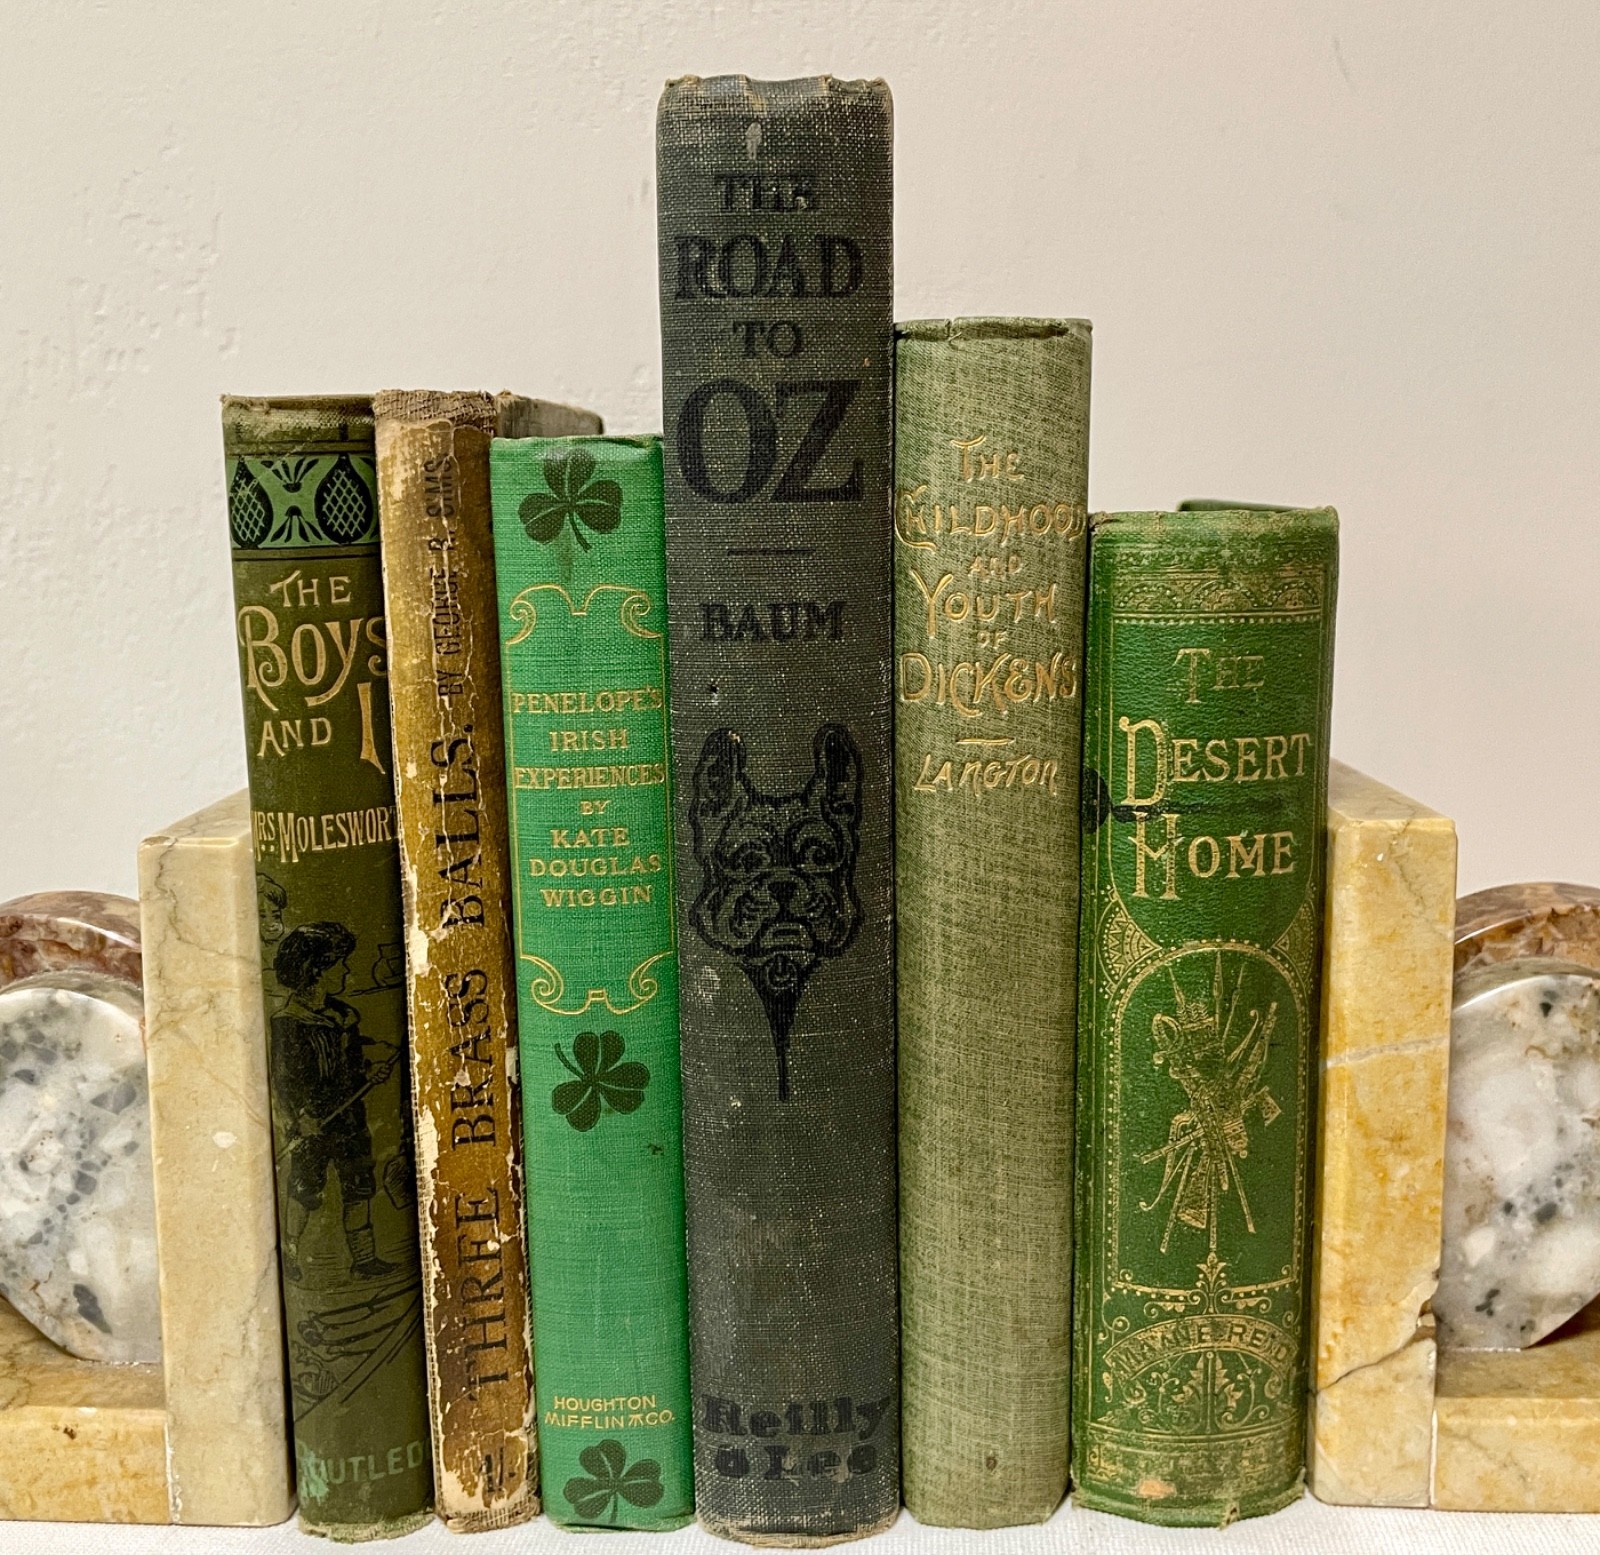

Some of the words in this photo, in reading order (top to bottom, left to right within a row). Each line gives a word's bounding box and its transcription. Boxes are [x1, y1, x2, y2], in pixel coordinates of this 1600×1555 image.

[675, 235, 863, 299] ROAD
[732, 319, 804, 358] TO
[677, 378, 863, 503] OZ
[950, 434, 1025, 483] THE
[423, 452, 456, 519] SIMS
[269, 569, 351, 608] THE
[429, 567, 460, 656] GEORGE
[911, 568, 1058, 639] YOUTH
[702, 601, 845, 641] BAUM
[436, 669, 463, 697] BY
[511, 685, 664, 714] PENELOPE'S
[901, 652, 1077, 717] DICKENS
[1173, 647, 1266, 704] THE
[256, 717, 332, 758] AND
[357, 682, 386, 774] I
[549, 729, 630, 752] IRISH
[514, 763, 666, 789] EXPERIENCES
[1118, 715, 1312, 807] DESERT
[430, 724, 486, 929] BALLS.
[580, 799, 612, 816] BY
[551, 827, 631, 849] KATE
[1127, 810, 1298, 901] HOME
[529, 854, 662, 878] DOUGLAS
[541, 884, 653, 908] WIGGIN
[444, 968, 497, 1152] BRASS
[455, 1186, 510, 1402] THREE
[544, 1411, 625, 1430] MIFFLIN
[553, 1394, 657, 1412] HOUGHTON
[701, 1393, 891, 1442] Reilly
